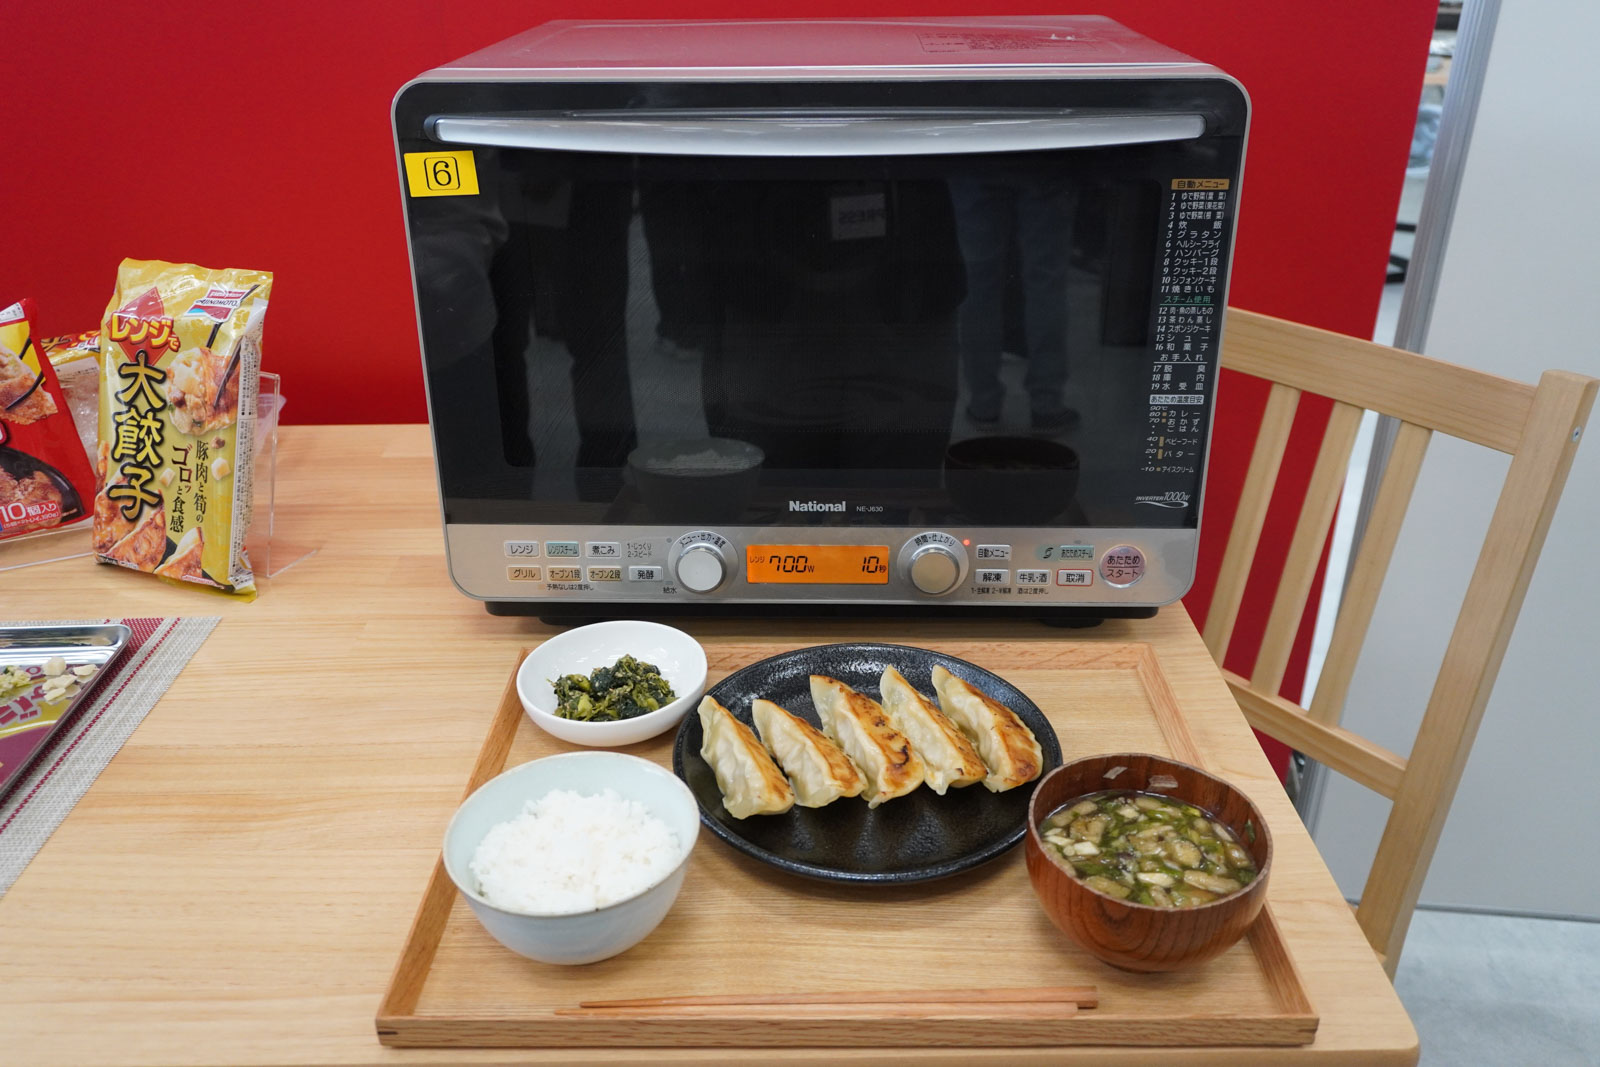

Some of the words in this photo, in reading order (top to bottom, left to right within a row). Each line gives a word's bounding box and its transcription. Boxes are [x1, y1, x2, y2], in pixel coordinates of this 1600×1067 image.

[433, 161, 451, 186] 6
[1178, 180, 1224, 188] 自動メニュー
[1177, 230, 1221, 238] グラタン
[1176, 240, 1220, 248] ヘルシーフライ
[1175, 249, 1219, 257] ハンバーグ
[1173, 267, 1216, 275] クッキー2段
[110, 312, 180, 351] レンジで
[1167, 343, 1208, 351] 和菓子
[108, 349, 167, 522] 大餃子
[194, 440, 208, 523] 豚肉と筍の
[170, 444, 192, 533] ゴロッと食感
[789, 501, 846, 512] National
[0, 503, 56, 522] 10個入り
[511, 545, 533, 554] レンジ
[548, 545, 578, 554] レンジスチーム
[592, 545, 615, 555] 煮こみ
[977, 550, 1009, 558] 自動メニュー
[770, 556, 814, 573] 700W
[1107, 555, 1140, 565] あたため
[862, 557, 886, 573] 10秒
[514, 569, 535, 578] グリル
[550, 570, 580, 579] オーブン1段
[590, 570, 620, 579] オーブン2段
[637, 570, 654, 579] 発酵
[1107, 569, 1139, 578] スタート
[983, 574, 1002, 583] 解凍
[1020, 574, 1047, 583] 牛乳・酒
[1066, 574, 1084, 583] 取消
